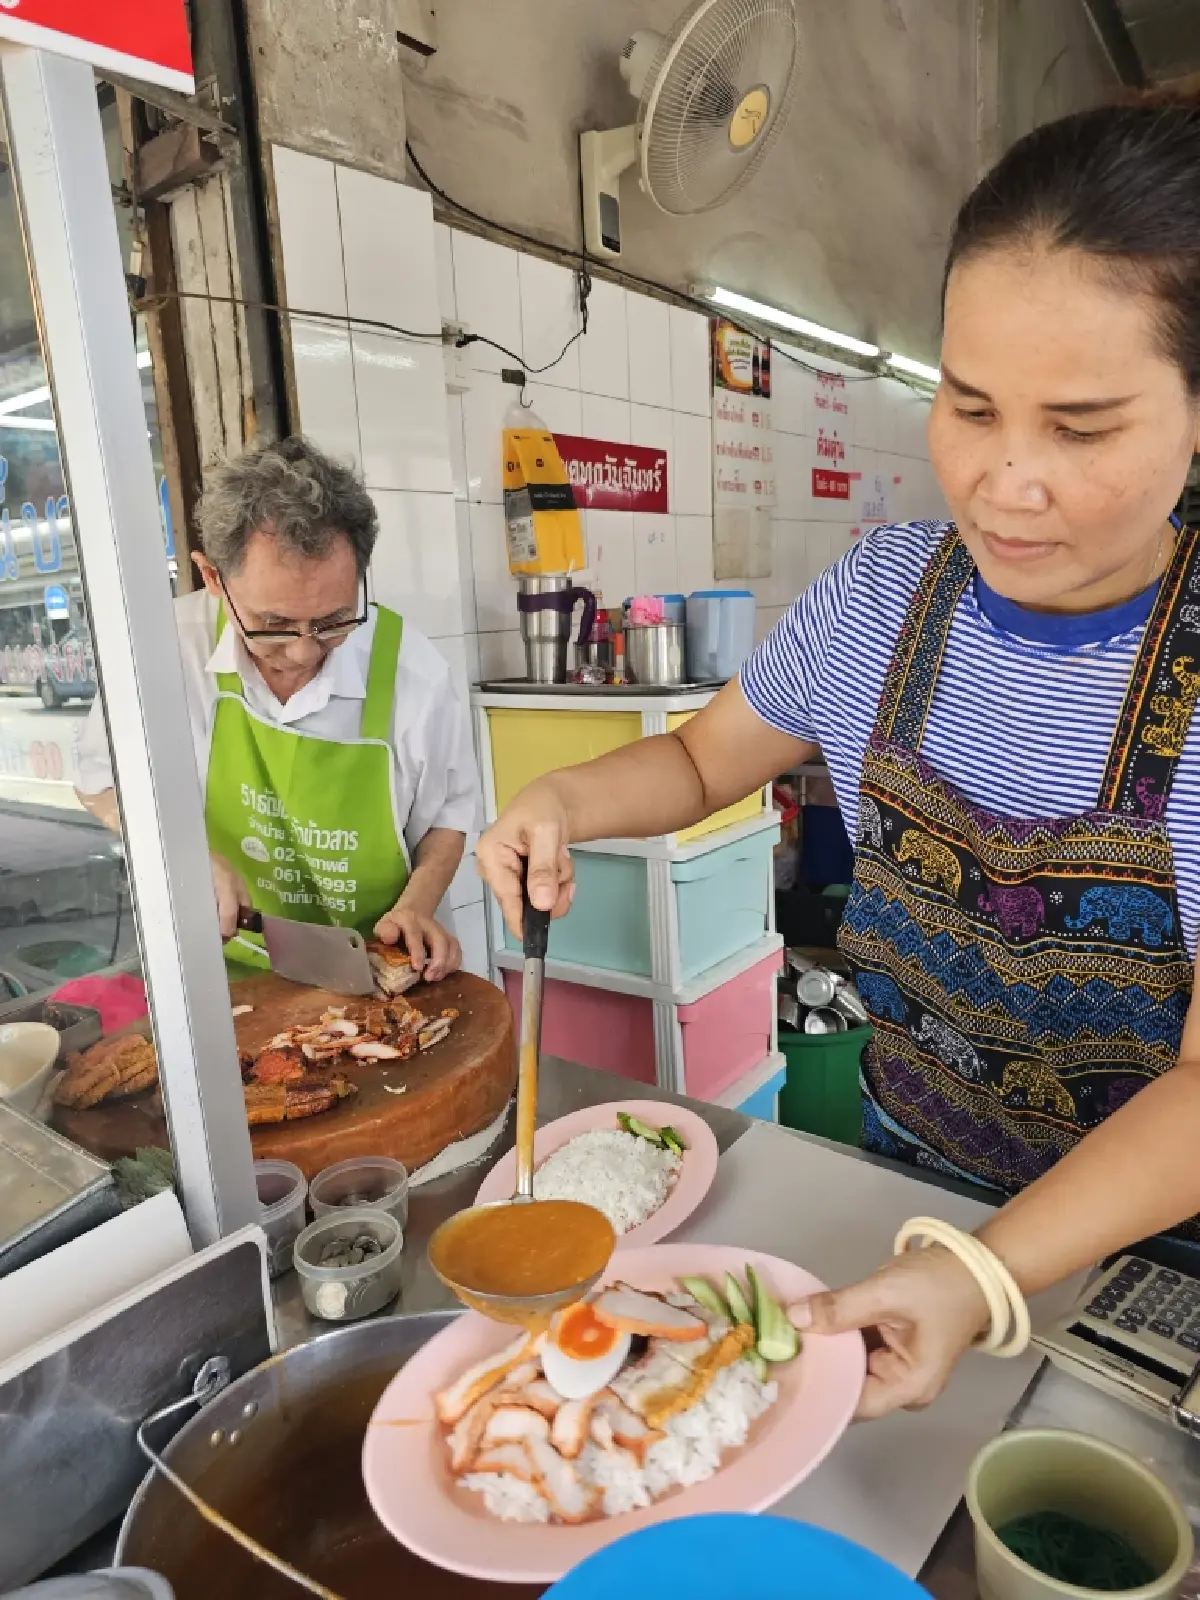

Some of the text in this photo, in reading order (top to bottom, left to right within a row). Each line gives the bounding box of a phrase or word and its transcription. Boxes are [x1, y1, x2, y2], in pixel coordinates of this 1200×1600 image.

[565, 453, 665, 504] ดทุกวันจันทร์
